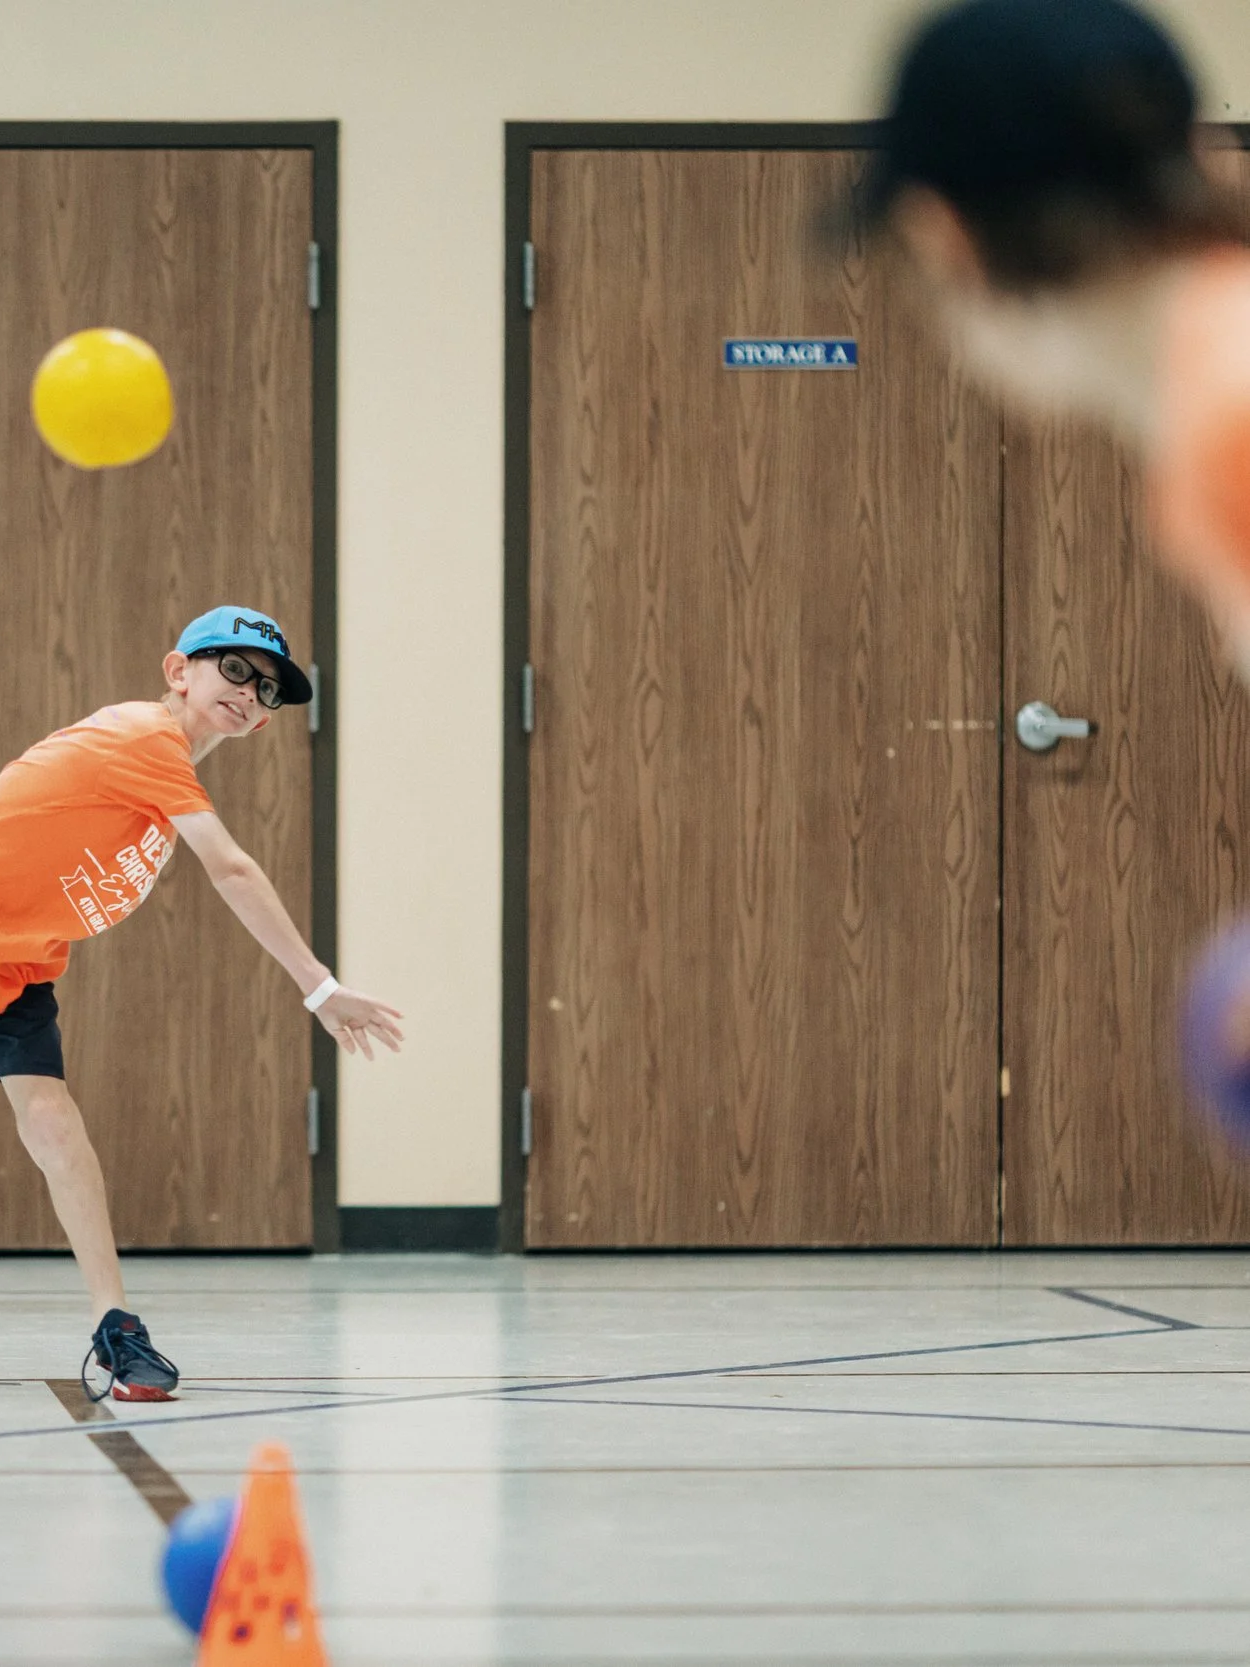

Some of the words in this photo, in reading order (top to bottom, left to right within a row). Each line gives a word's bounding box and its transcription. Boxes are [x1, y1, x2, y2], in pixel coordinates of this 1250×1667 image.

[732, 343, 826, 365] STORAGE
[832, 343, 848, 364] A
[78, 896, 97, 917] 4TH
